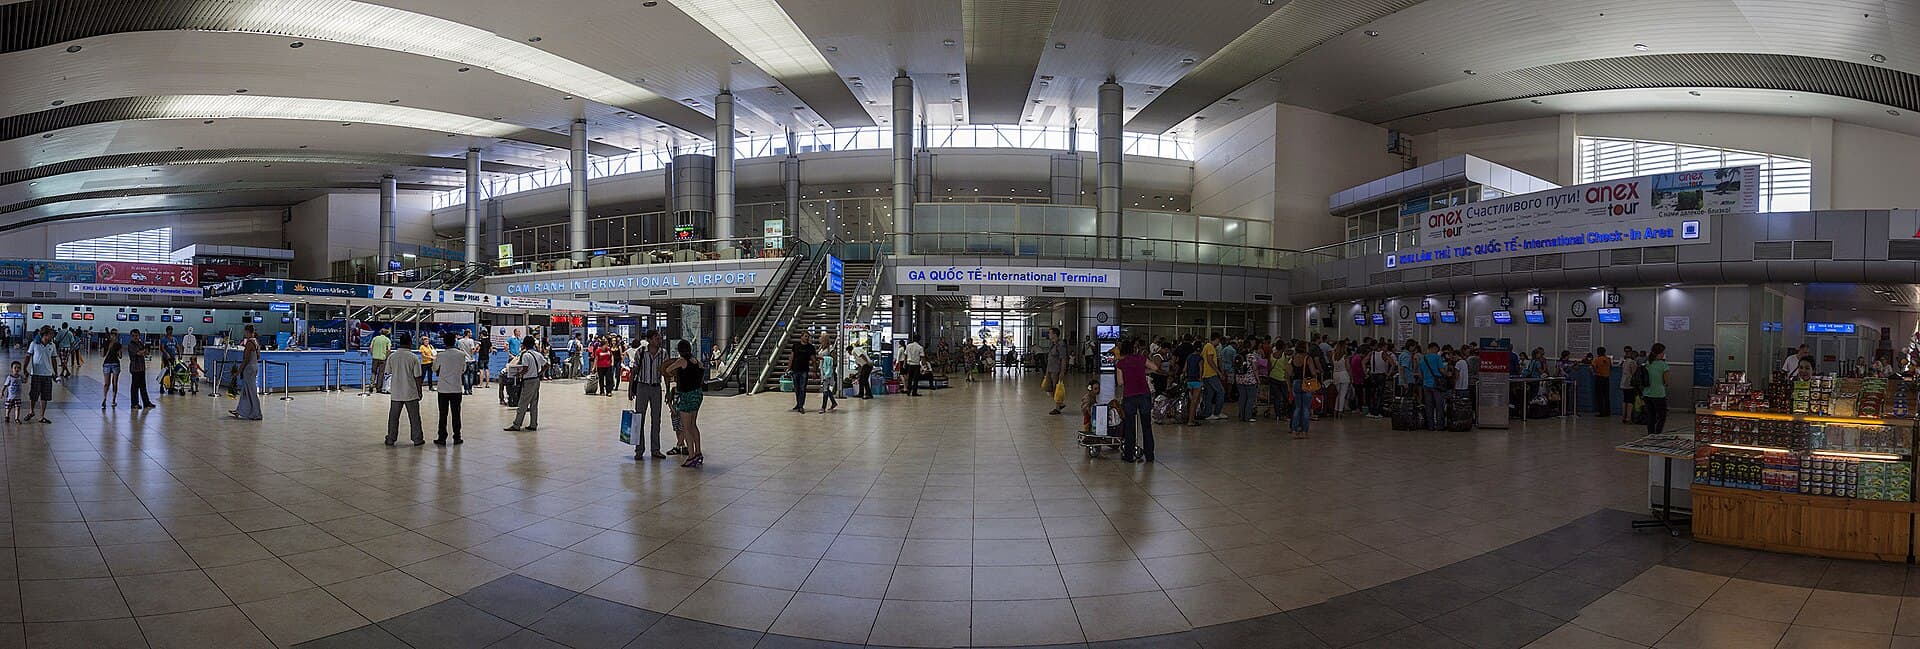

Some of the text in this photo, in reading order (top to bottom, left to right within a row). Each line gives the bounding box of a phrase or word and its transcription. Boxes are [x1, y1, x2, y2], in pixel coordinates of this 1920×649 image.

[1678, 172, 1704, 182] anex
[1586, 182, 1640, 204] anex
[1466, 198, 1542, 219] Счастливого
[1547, 190, 1580, 210] пути!
[1608, 202, 1640, 216] tour
[1428, 209, 1463, 228] anex
[1442, 225, 1463, 238] tour
[1474, 238, 1501, 254] QUỐC
[1644, 226, 1674, 240] Area
[908, 270, 926, 280] GA
[930, 266, 964, 281] QUỐC
[1060, 272, 1107, 283] Terminal
[508, 272, 757, 294] CAM RANH INTERNATIONAL AIRPORT
[330, 287, 350, 295] Airlines
[1608, 294, 1618, 303] 30
[1534, 296, 1542, 304] 31
